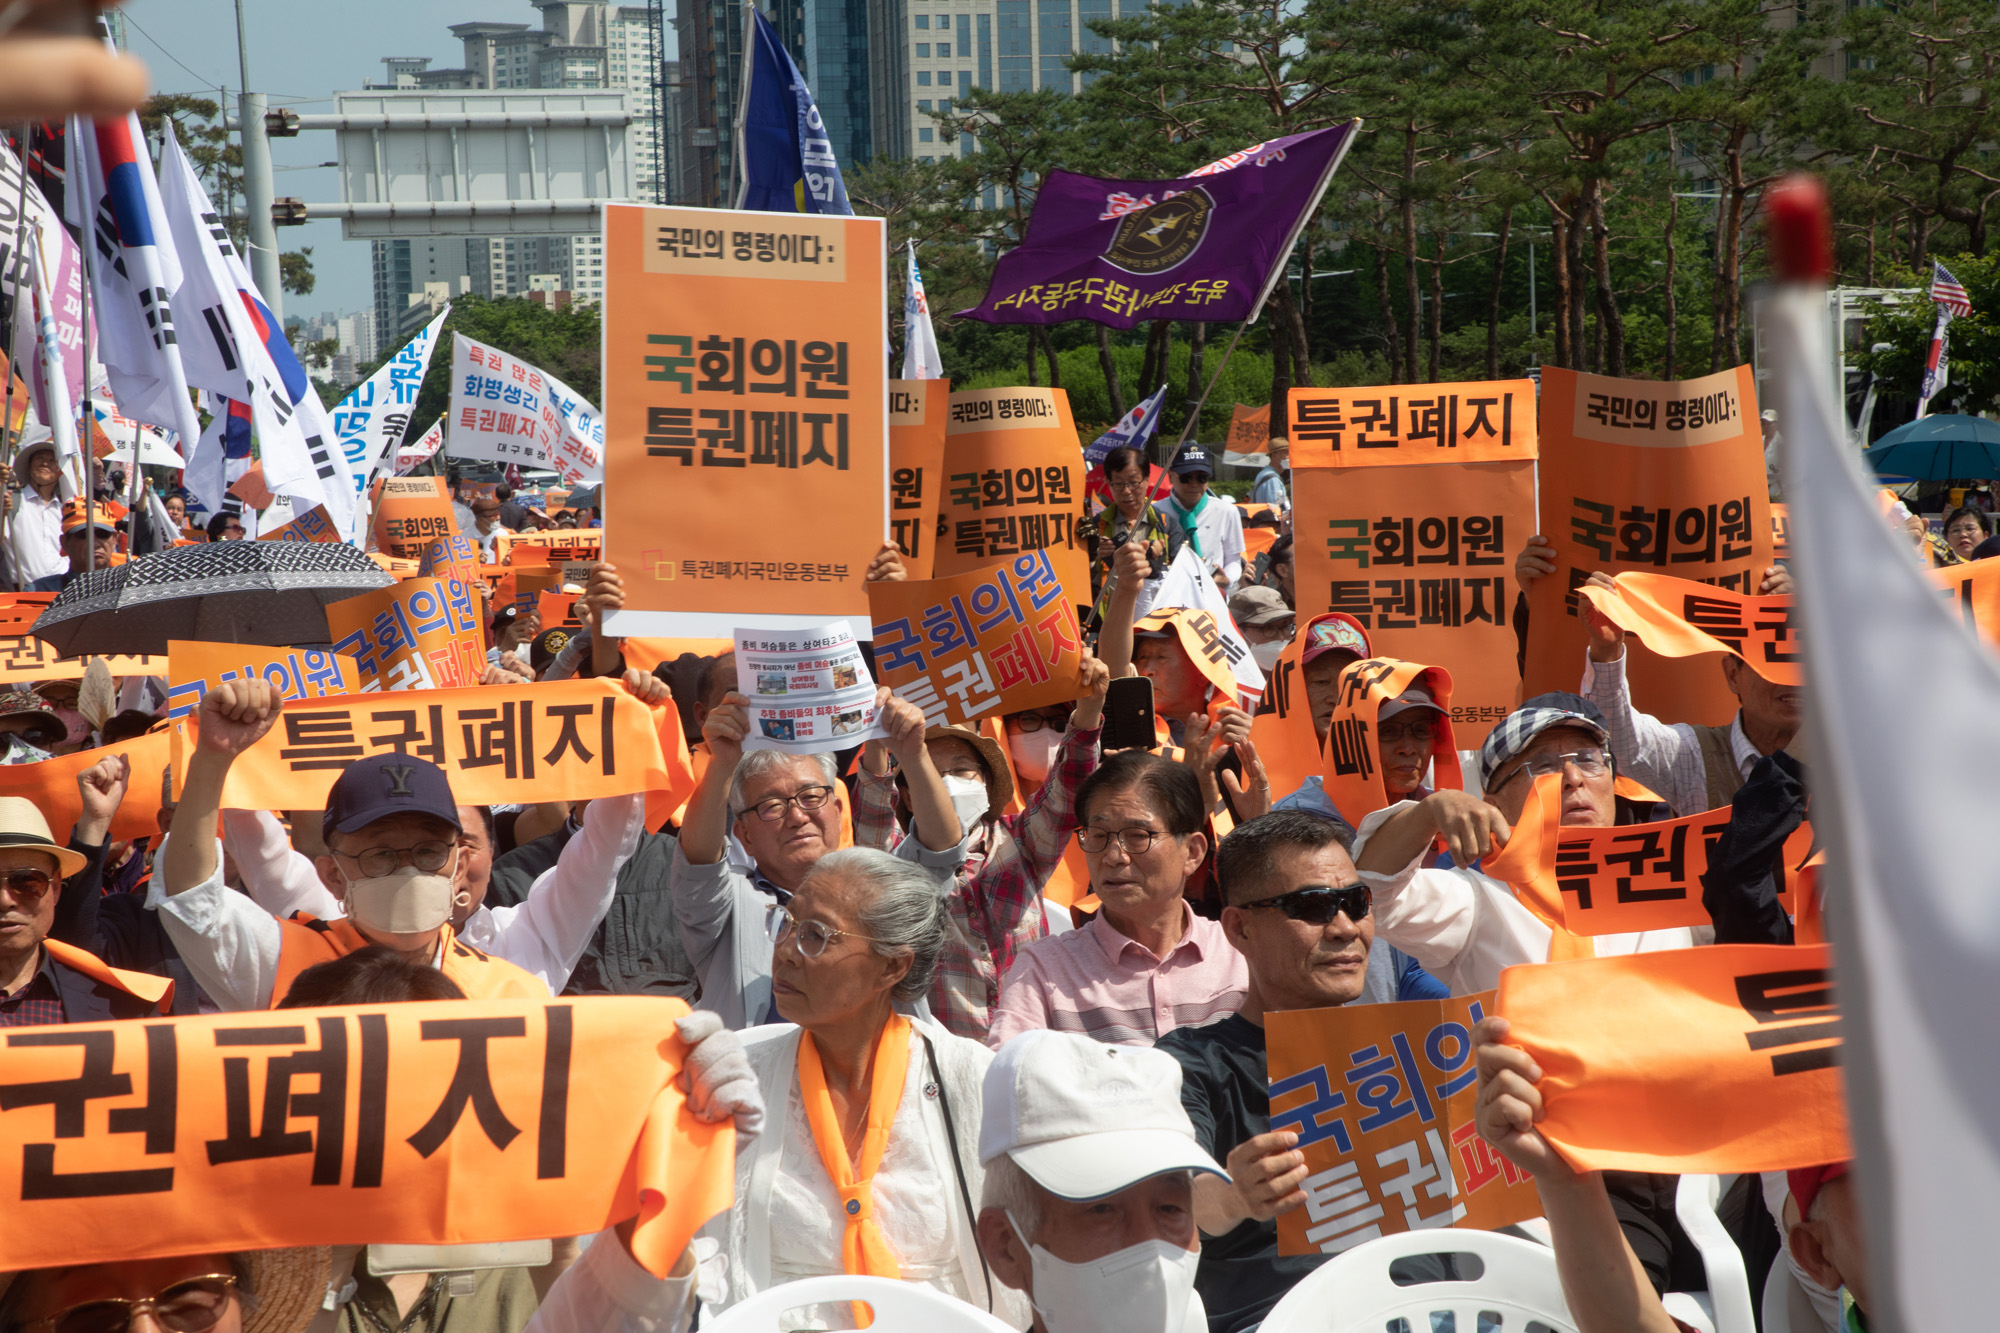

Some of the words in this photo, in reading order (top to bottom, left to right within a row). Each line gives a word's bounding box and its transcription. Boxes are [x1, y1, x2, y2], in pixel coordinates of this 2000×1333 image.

[657, 226, 724, 260] 국민의
[469, 346, 502, 372] 특권
[512, 363, 542, 392] 많은
[644, 334, 850, 400] 국회의원
[460, 407, 537, 439] 특권폐지
[952, 400, 994, 424] 국민의
[1292, 393, 1514, 452] 특권폐지
[1587, 393, 1658, 431] 국민의
[644, 407, 850, 471] 특권폐지
[1184, 450, 1205, 461] ROTC
[950, 466, 1072, 511] 국회의원
[386, 517, 450, 539] 국회의원
[955, 513, 1074, 558] 특권폐지
[1327, 516, 1505, 568] 국회의원
[1571, 496, 1753, 566] 국회의원
[681, 560, 850, 582] 특권폐지국민운동본부
[332, 579, 477, 676] 국회의원
[873, 549, 1063, 673] 국회의원
[1328, 577, 1506, 630] 특권폐지
[361, 634, 484, 693] 권폐지
[892, 597, 1083, 729] 특권폐지
[280, 696, 616, 780] 특권폐지
[381, 765, 416, 797] Y
[0, 1005, 573, 1201] 권폐지
[1269, 1000, 1486, 1155] 국회의
